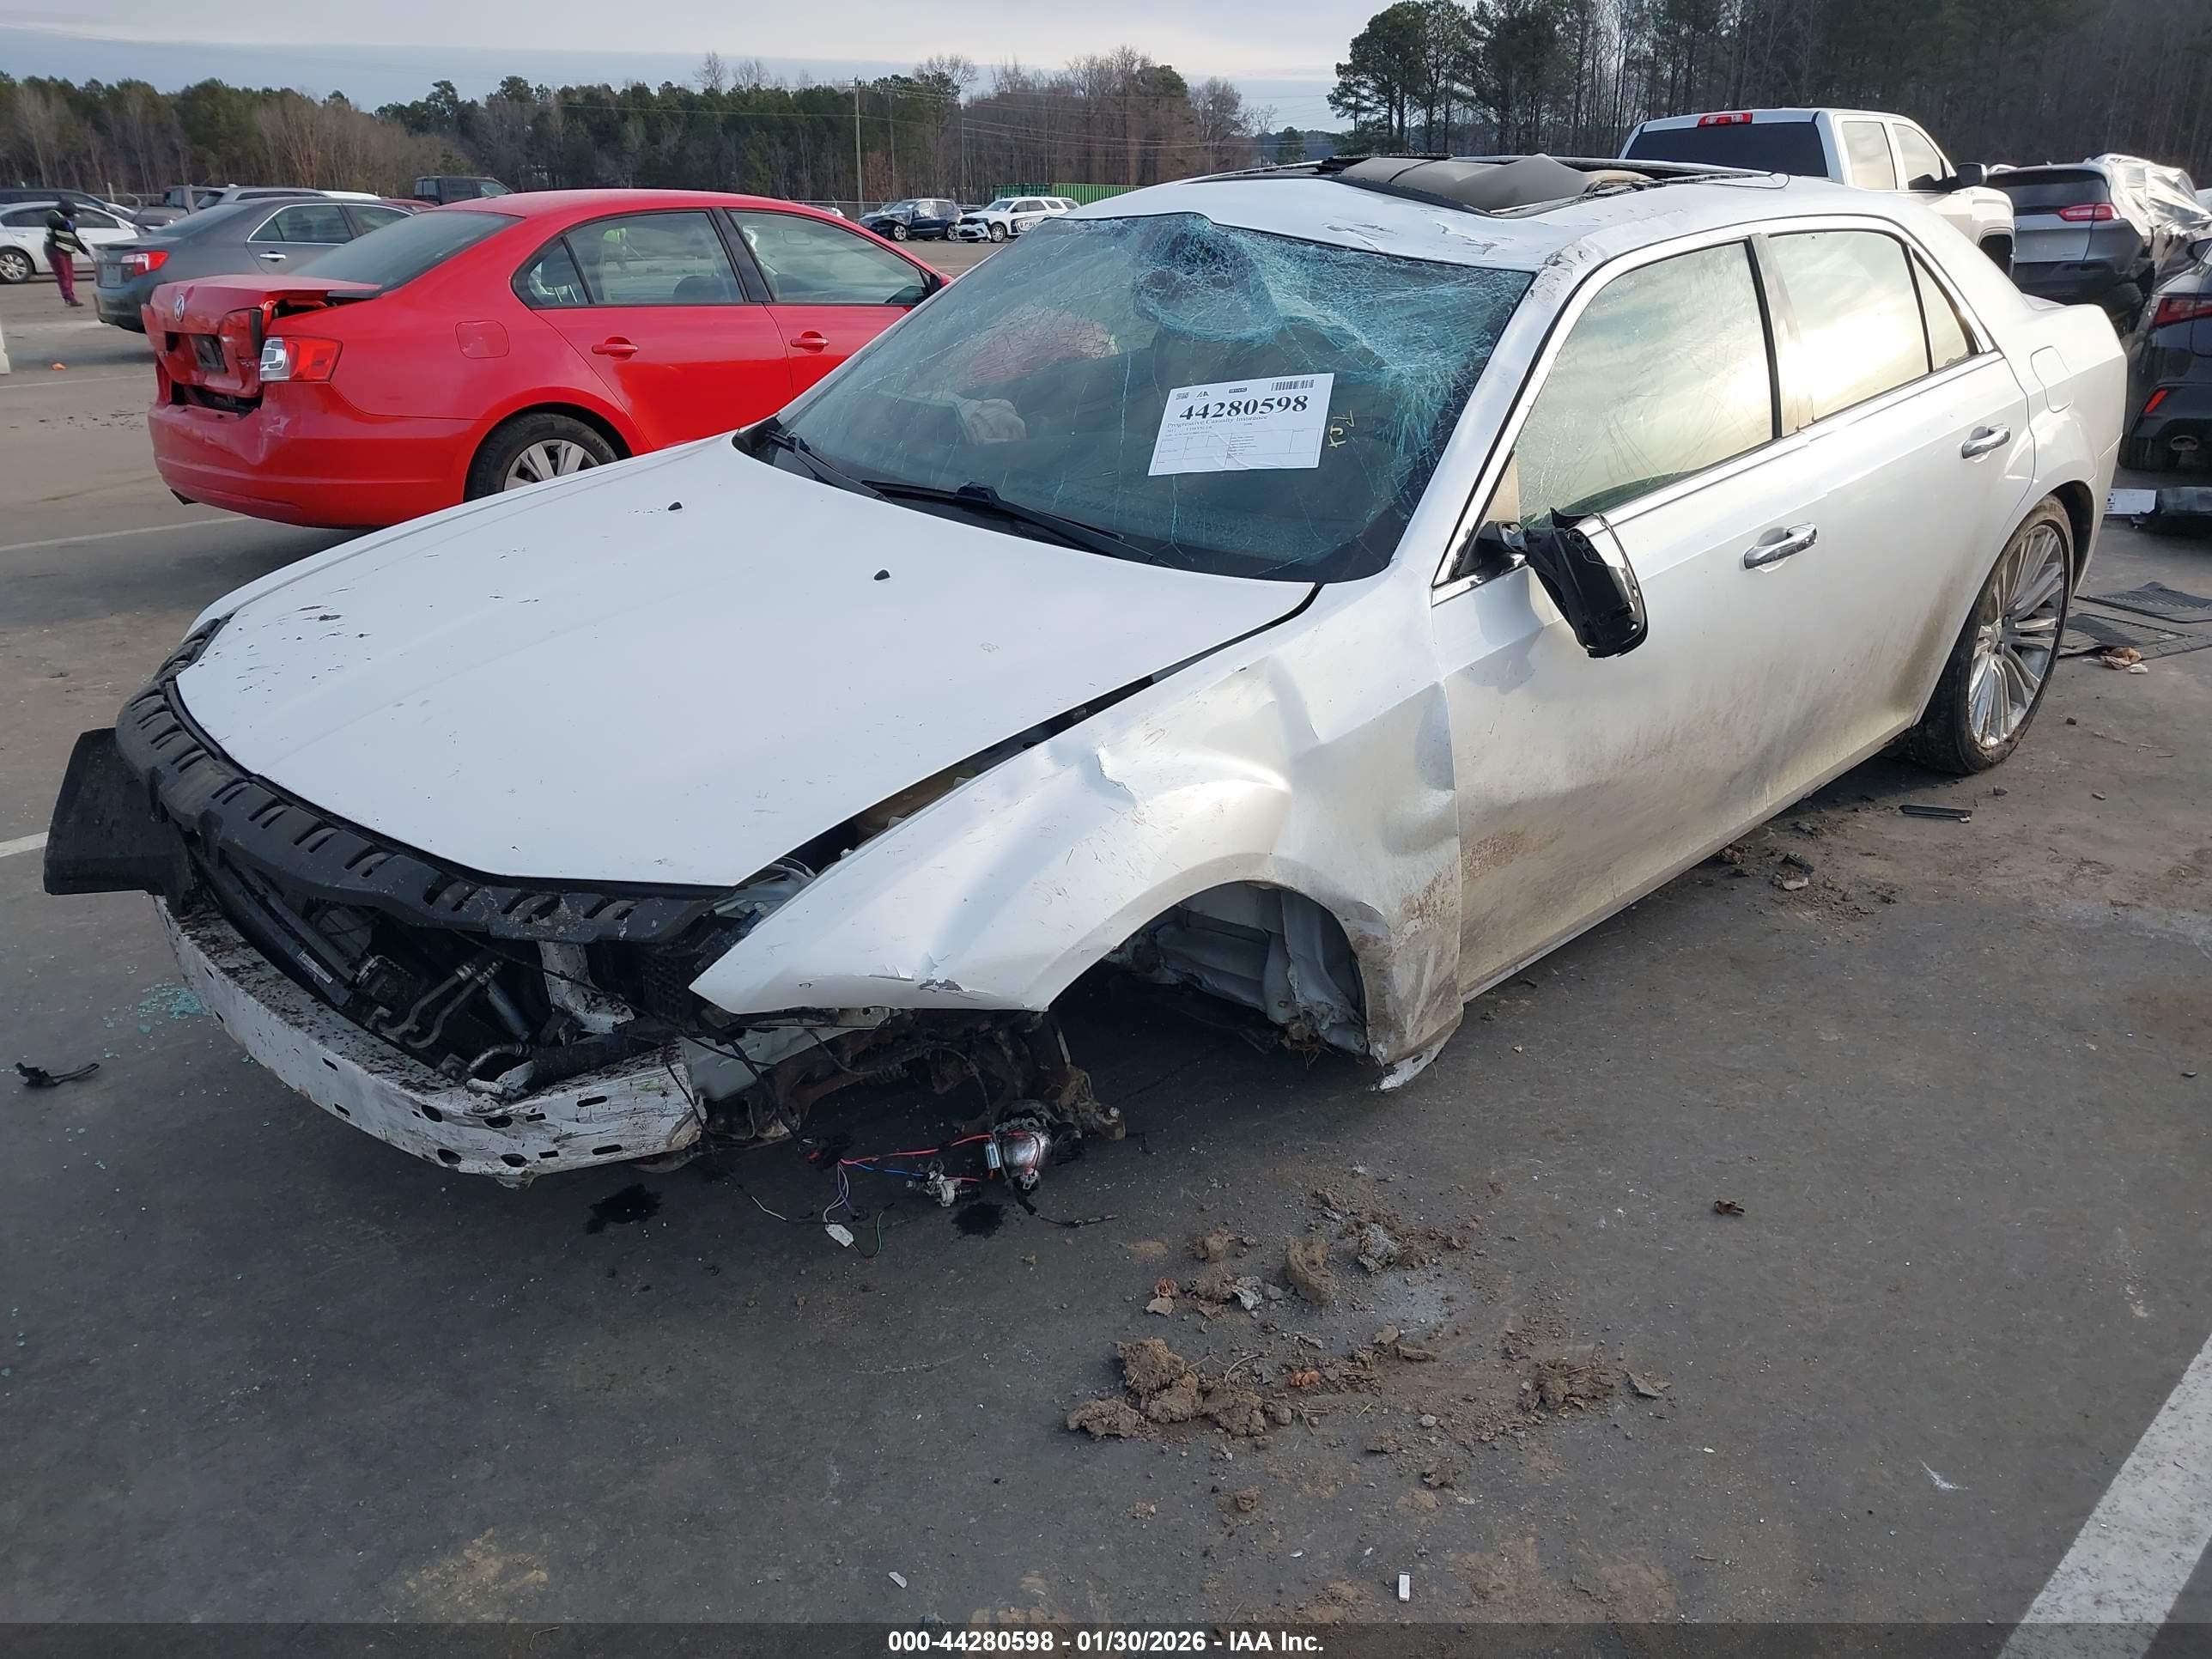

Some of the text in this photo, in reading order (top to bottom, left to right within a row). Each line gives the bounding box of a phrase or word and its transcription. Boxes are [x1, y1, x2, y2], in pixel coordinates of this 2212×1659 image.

[1179, 395, 1309, 420] 44280598
[1167, 419, 1204, 429] Progressive
[1206, 417, 1234, 426] Casualty
